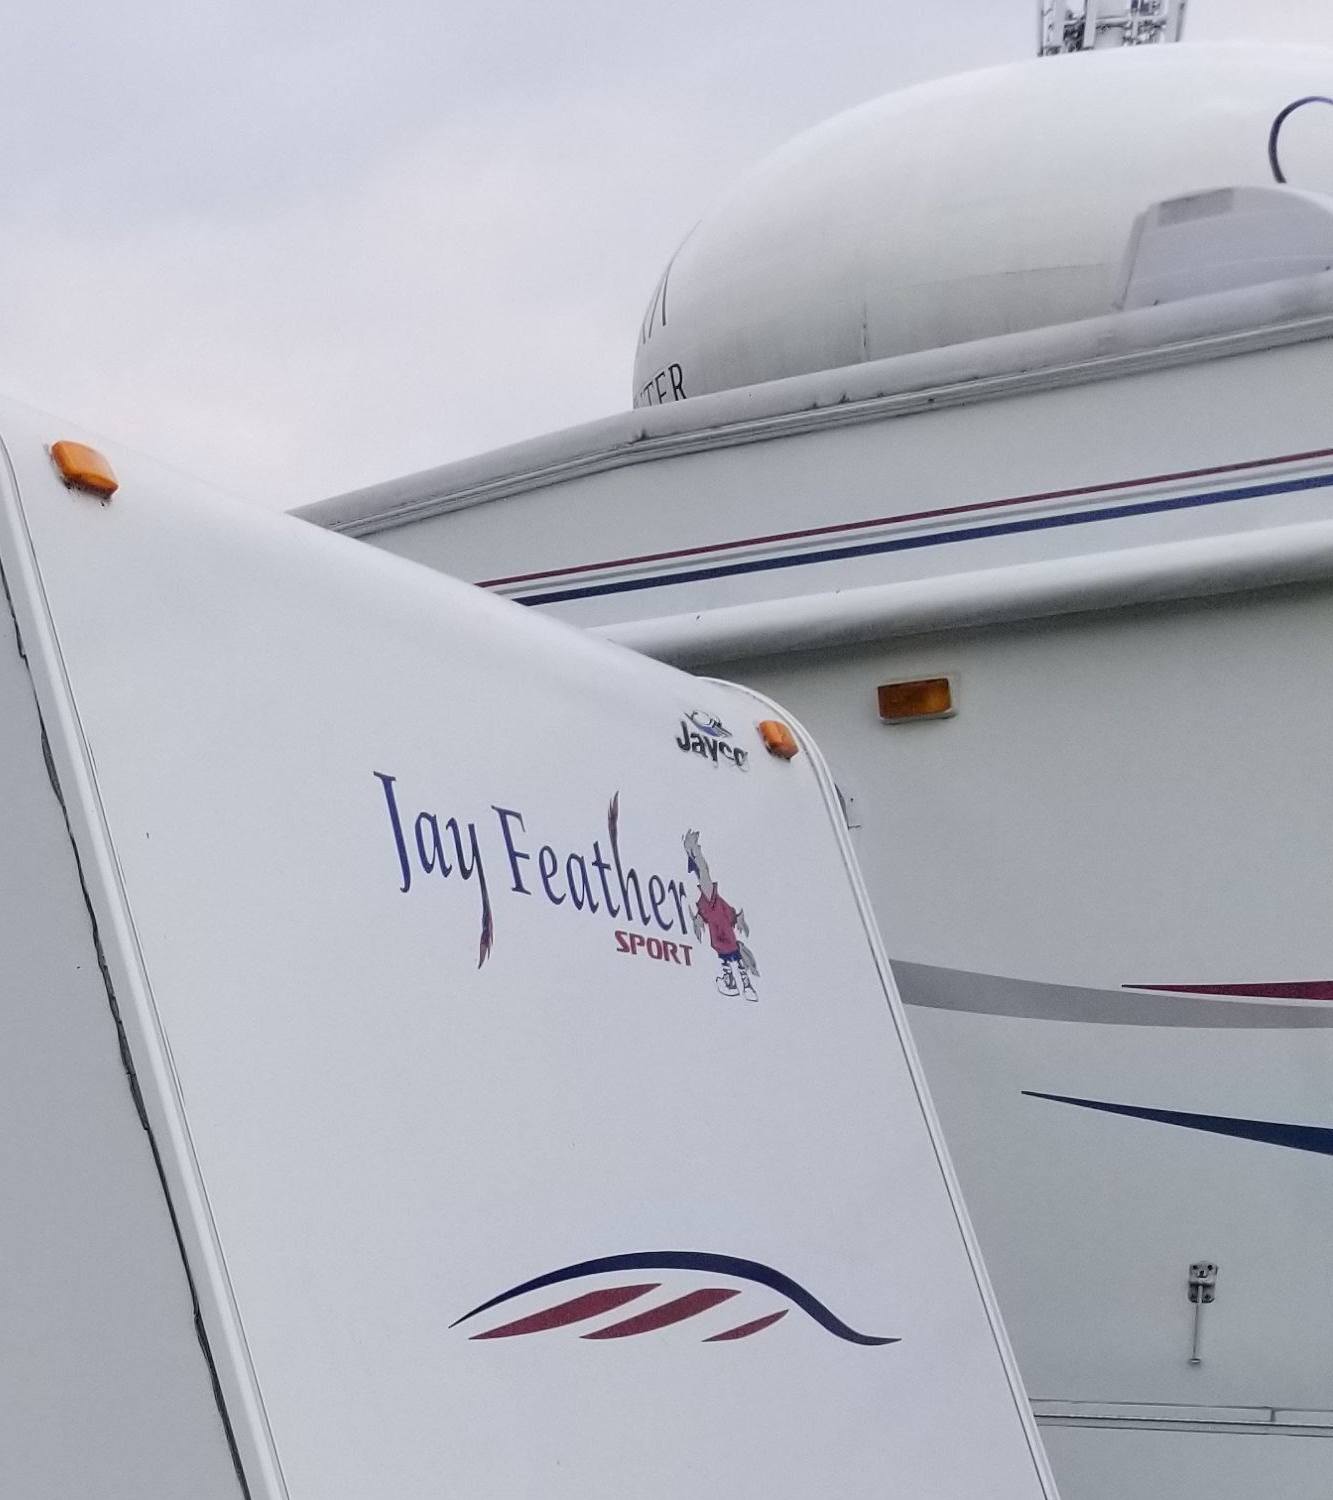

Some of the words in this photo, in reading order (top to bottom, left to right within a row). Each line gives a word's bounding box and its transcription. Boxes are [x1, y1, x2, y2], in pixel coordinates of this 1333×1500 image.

[675, 719, 749, 773] Jayco
[373, 771, 493, 970] Jay
[491, 790, 688, 935] Feather
[614, 930, 694, 967] SPORT
